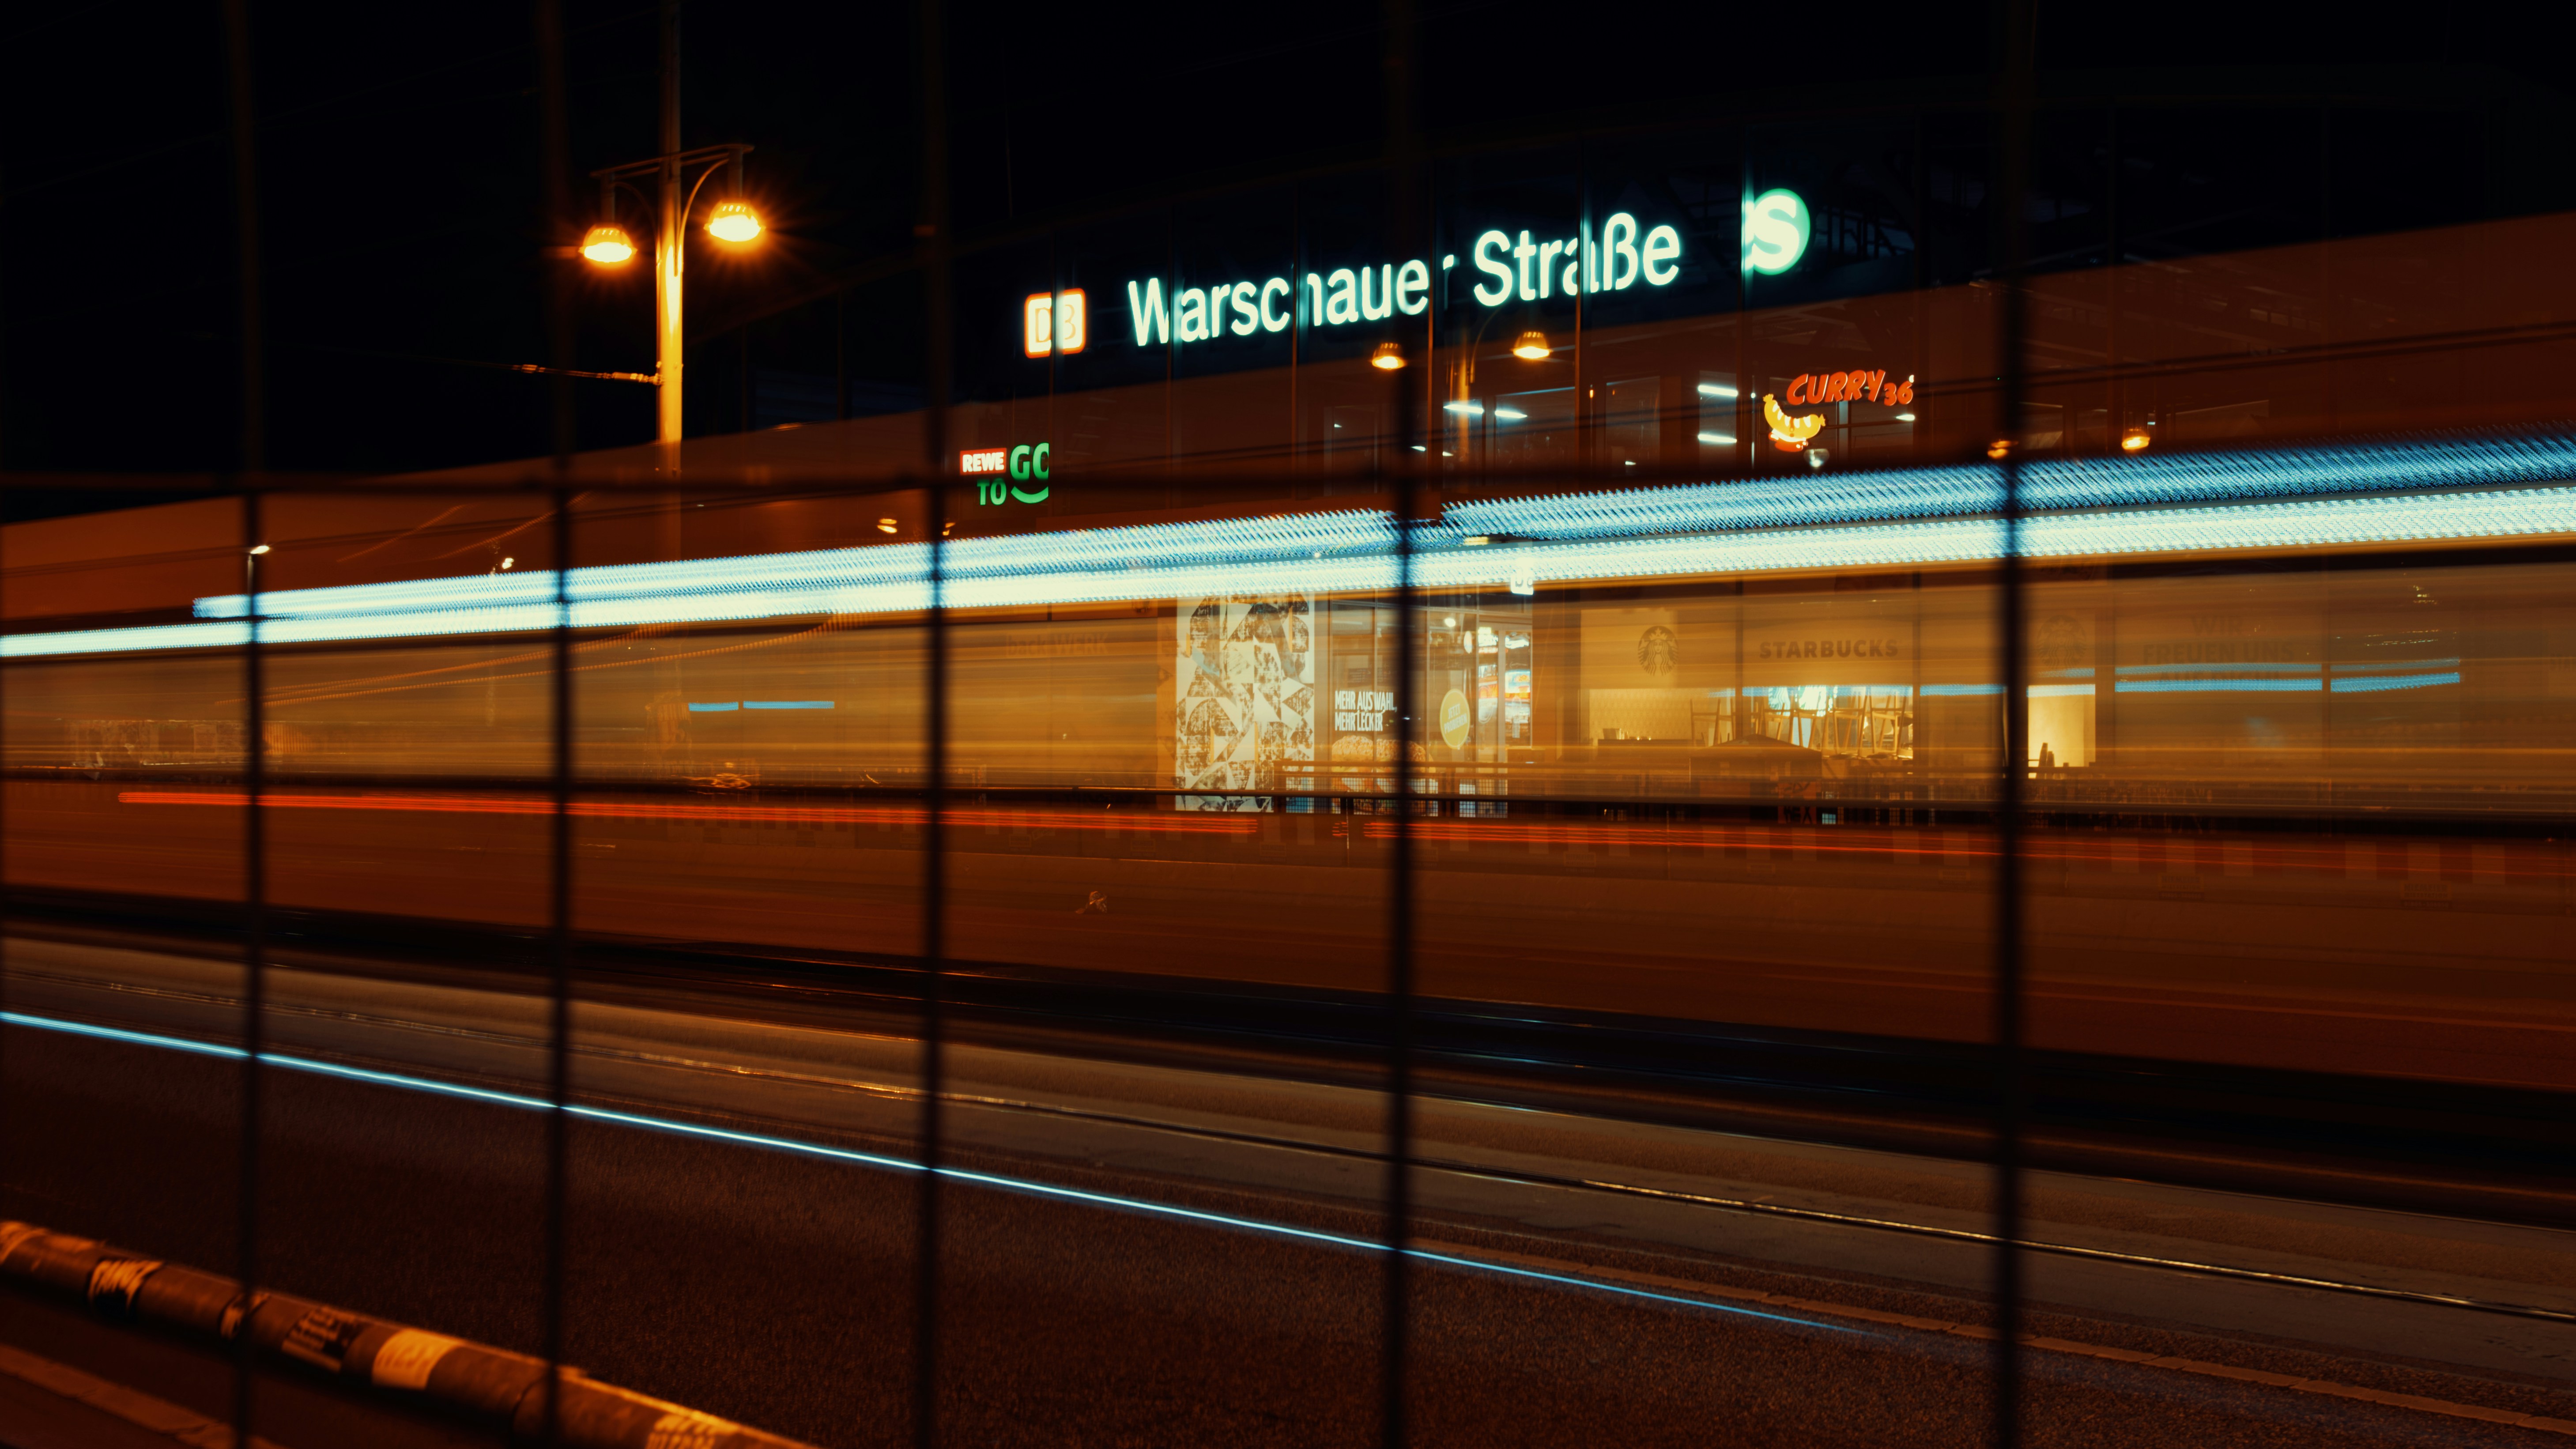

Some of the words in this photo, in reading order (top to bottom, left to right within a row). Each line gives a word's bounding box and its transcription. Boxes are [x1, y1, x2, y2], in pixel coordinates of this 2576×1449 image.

[1474, 212, 1680, 306] Straße
[1787, 369, 1886, 405] CURRY
[1884, 381, 1913, 406] 36
[962, 452, 1004, 473] REWE
[977, 478, 1007, 506] TO
[1759, 639, 1899, 660] STARBUCKS
[1335, 691, 1356, 710] MEHR
[1335, 712, 1356, 732] MEHR
[1357, 712, 1383, 732] LECKER
